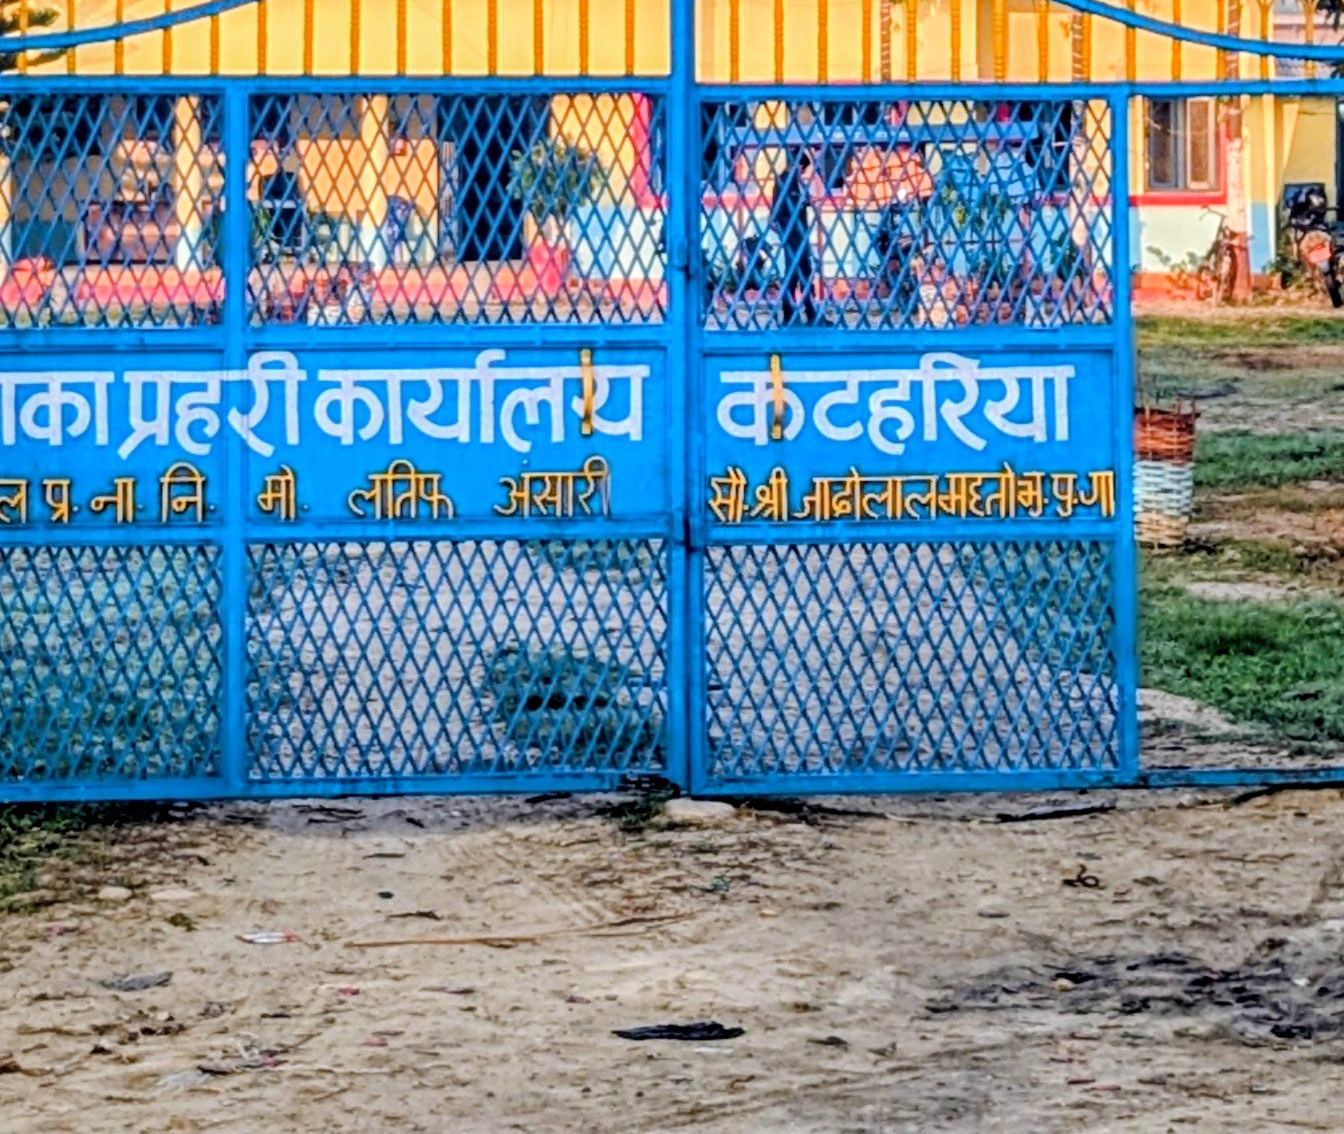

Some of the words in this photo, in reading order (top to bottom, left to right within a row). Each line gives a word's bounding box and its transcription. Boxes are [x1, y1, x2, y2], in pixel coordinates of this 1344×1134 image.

[117, 350, 307, 460] प्रहरी
[313, 349, 652, 454] कार्यालय
[716, 352, 1076, 456] कटहरिया
[347, 458, 454, 521] लतिफ
